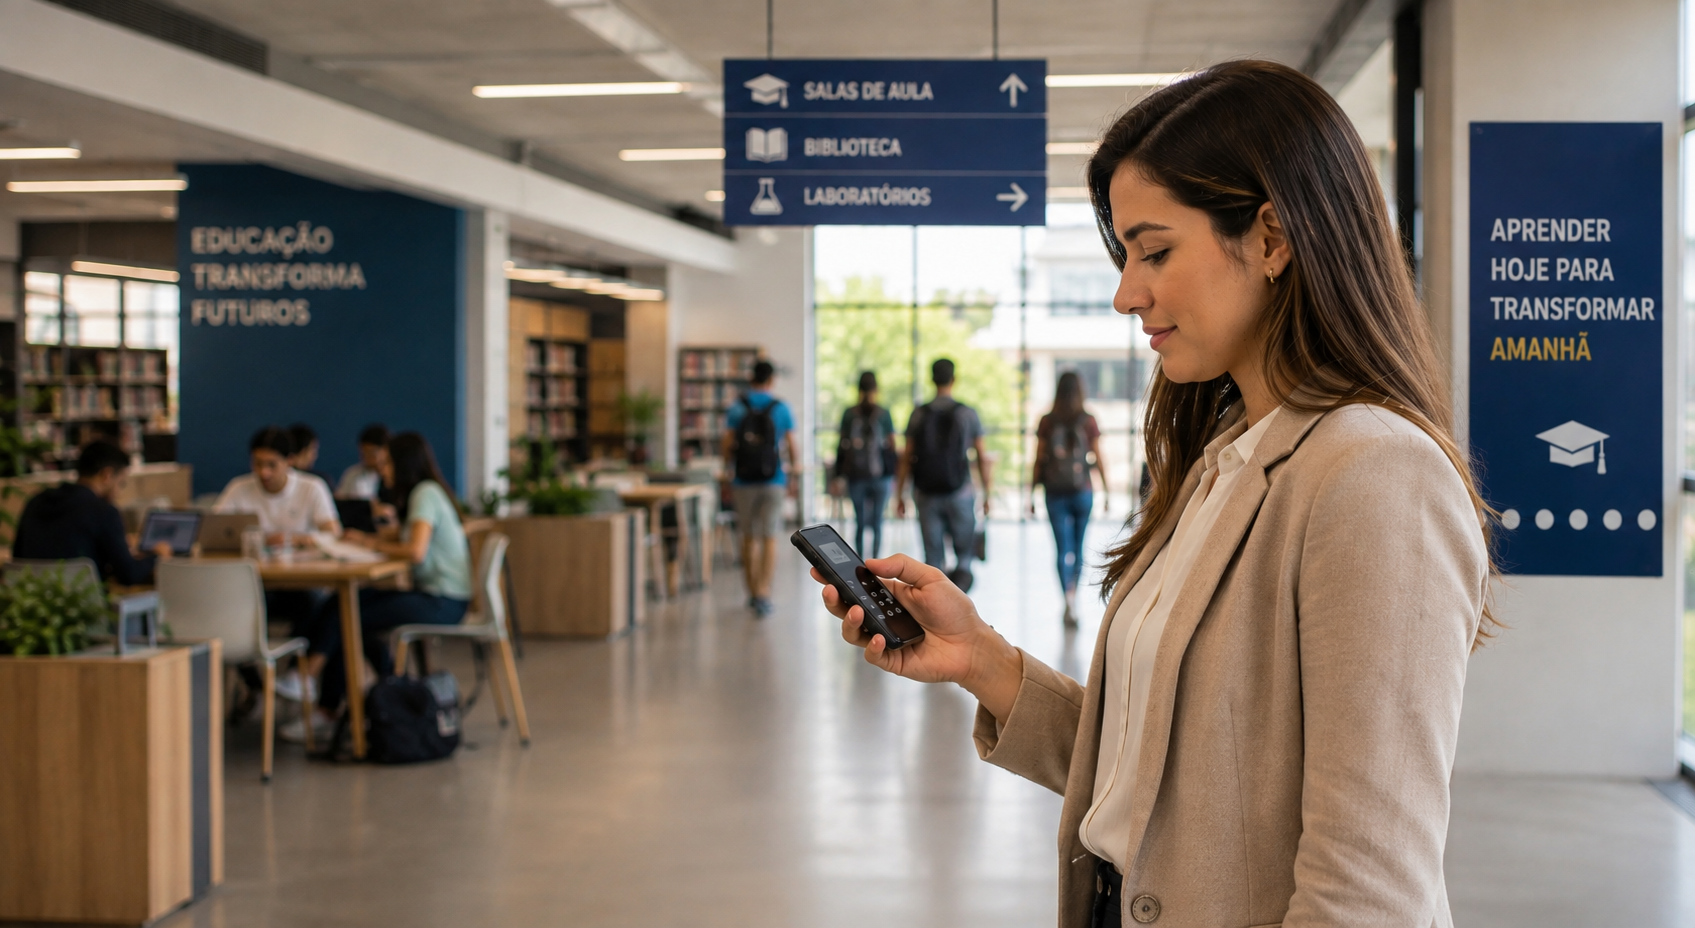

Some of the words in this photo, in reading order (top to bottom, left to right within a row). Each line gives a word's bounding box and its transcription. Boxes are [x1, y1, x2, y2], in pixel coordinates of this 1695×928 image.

[804, 81, 858, 100] SALAS
[862, 82, 885, 100] DE
[888, 81, 933, 100] AULA
[804, 138, 902, 157] BIBLIOTECA
[804, 183, 931, 206] LABORATÓRIOS
[190, 220, 334, 259] EDUCAÇÃO
[1490, 218, 1611, 242] APRENDER
[190, 262, 367, 290] TRANSFORMA
[1491, 257, 1549, 281] HOJE
[1556, 258, 1614, 281] PARA
[190, 298, 311, 326] FUTUROS
[1490, 297, 1655, 321] TRANSFORMAR
[1490, 331, 1591, 360] AMANHÃ
